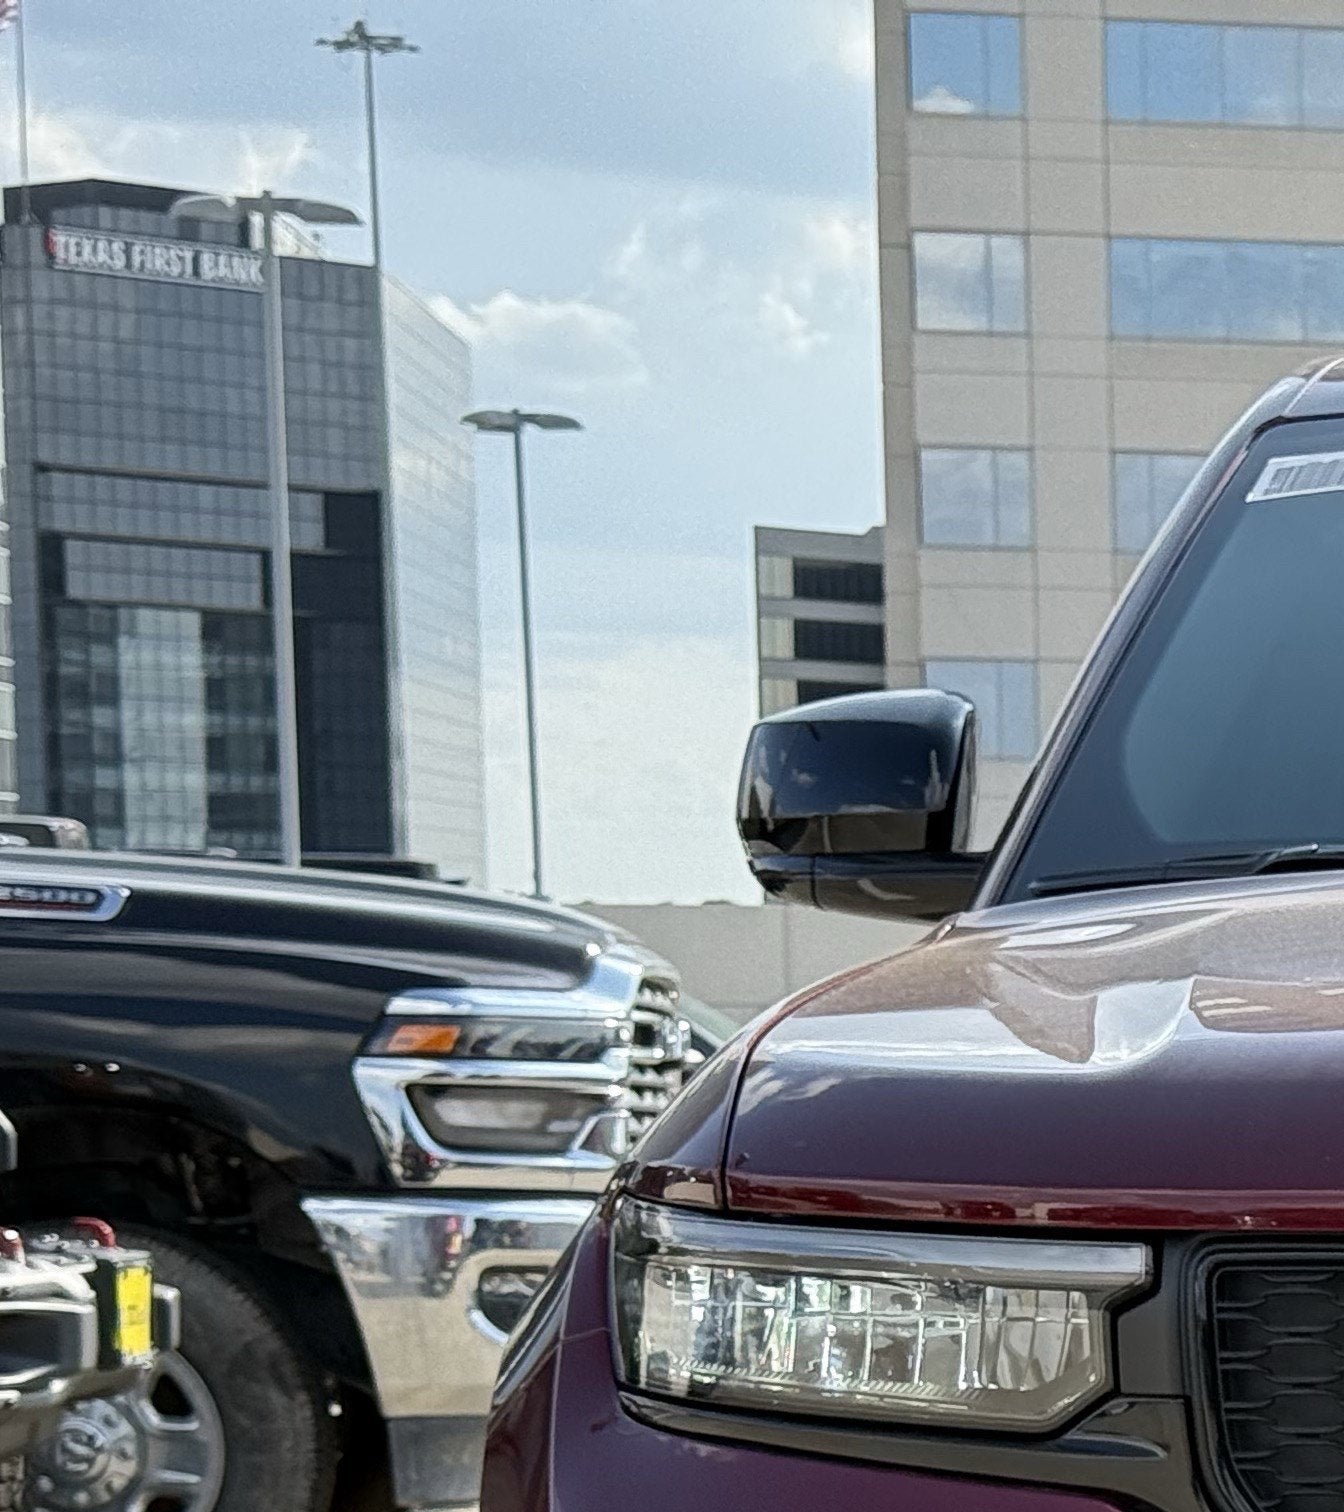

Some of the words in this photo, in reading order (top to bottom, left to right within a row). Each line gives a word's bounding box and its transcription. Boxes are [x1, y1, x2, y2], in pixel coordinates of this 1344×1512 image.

[56, 233, 127, 271] TEXAS
[131, 243, 193, 278] FIRST
[200, 251, 265, 284] BANK
